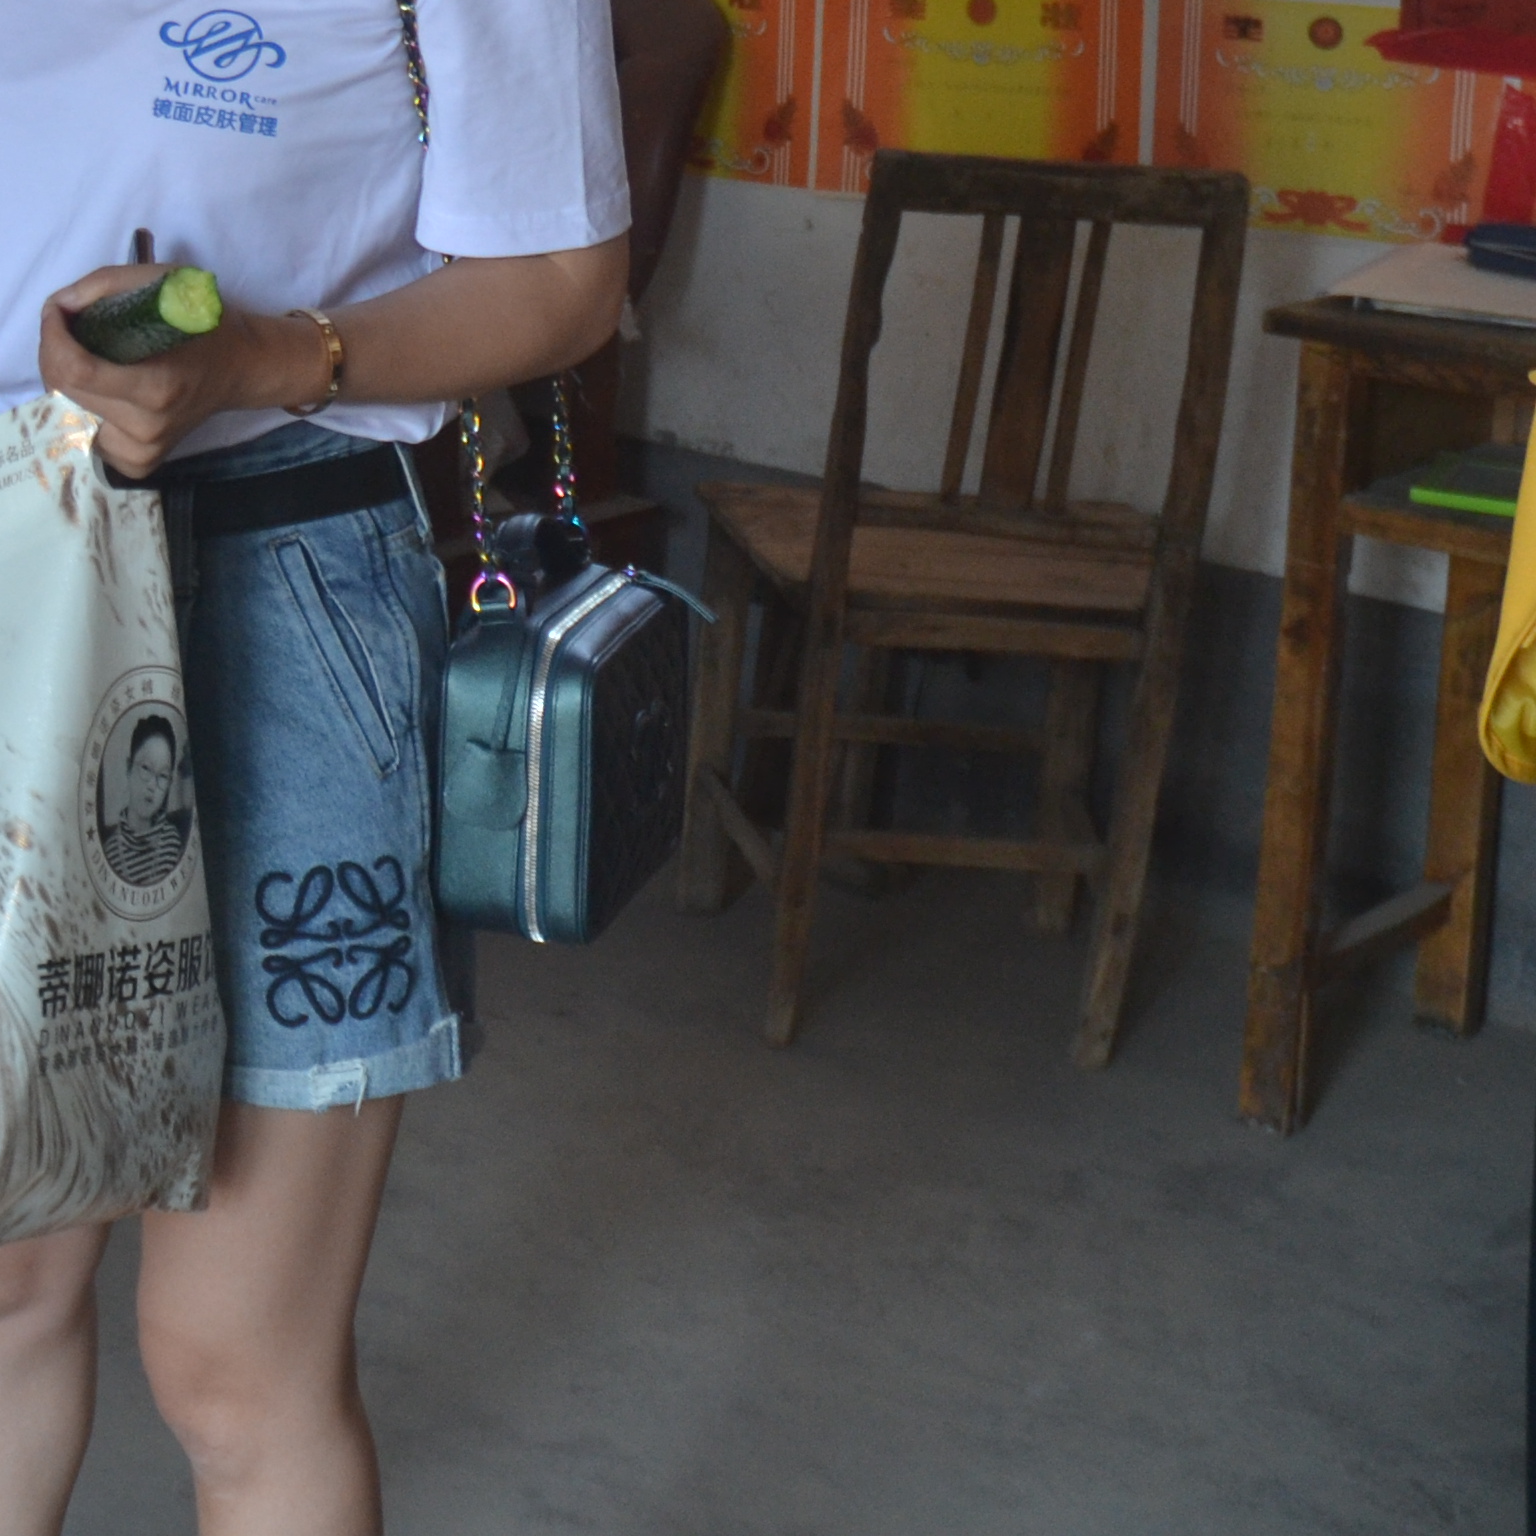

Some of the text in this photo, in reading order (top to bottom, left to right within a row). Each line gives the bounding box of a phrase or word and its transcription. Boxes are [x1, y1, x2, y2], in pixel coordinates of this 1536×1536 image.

[163, 76, 278, 110] MIRROR care
[152, 97, 278, 138] 镜面皮肤管理
[38, 1000, 166, 1050] DINANUOZI
